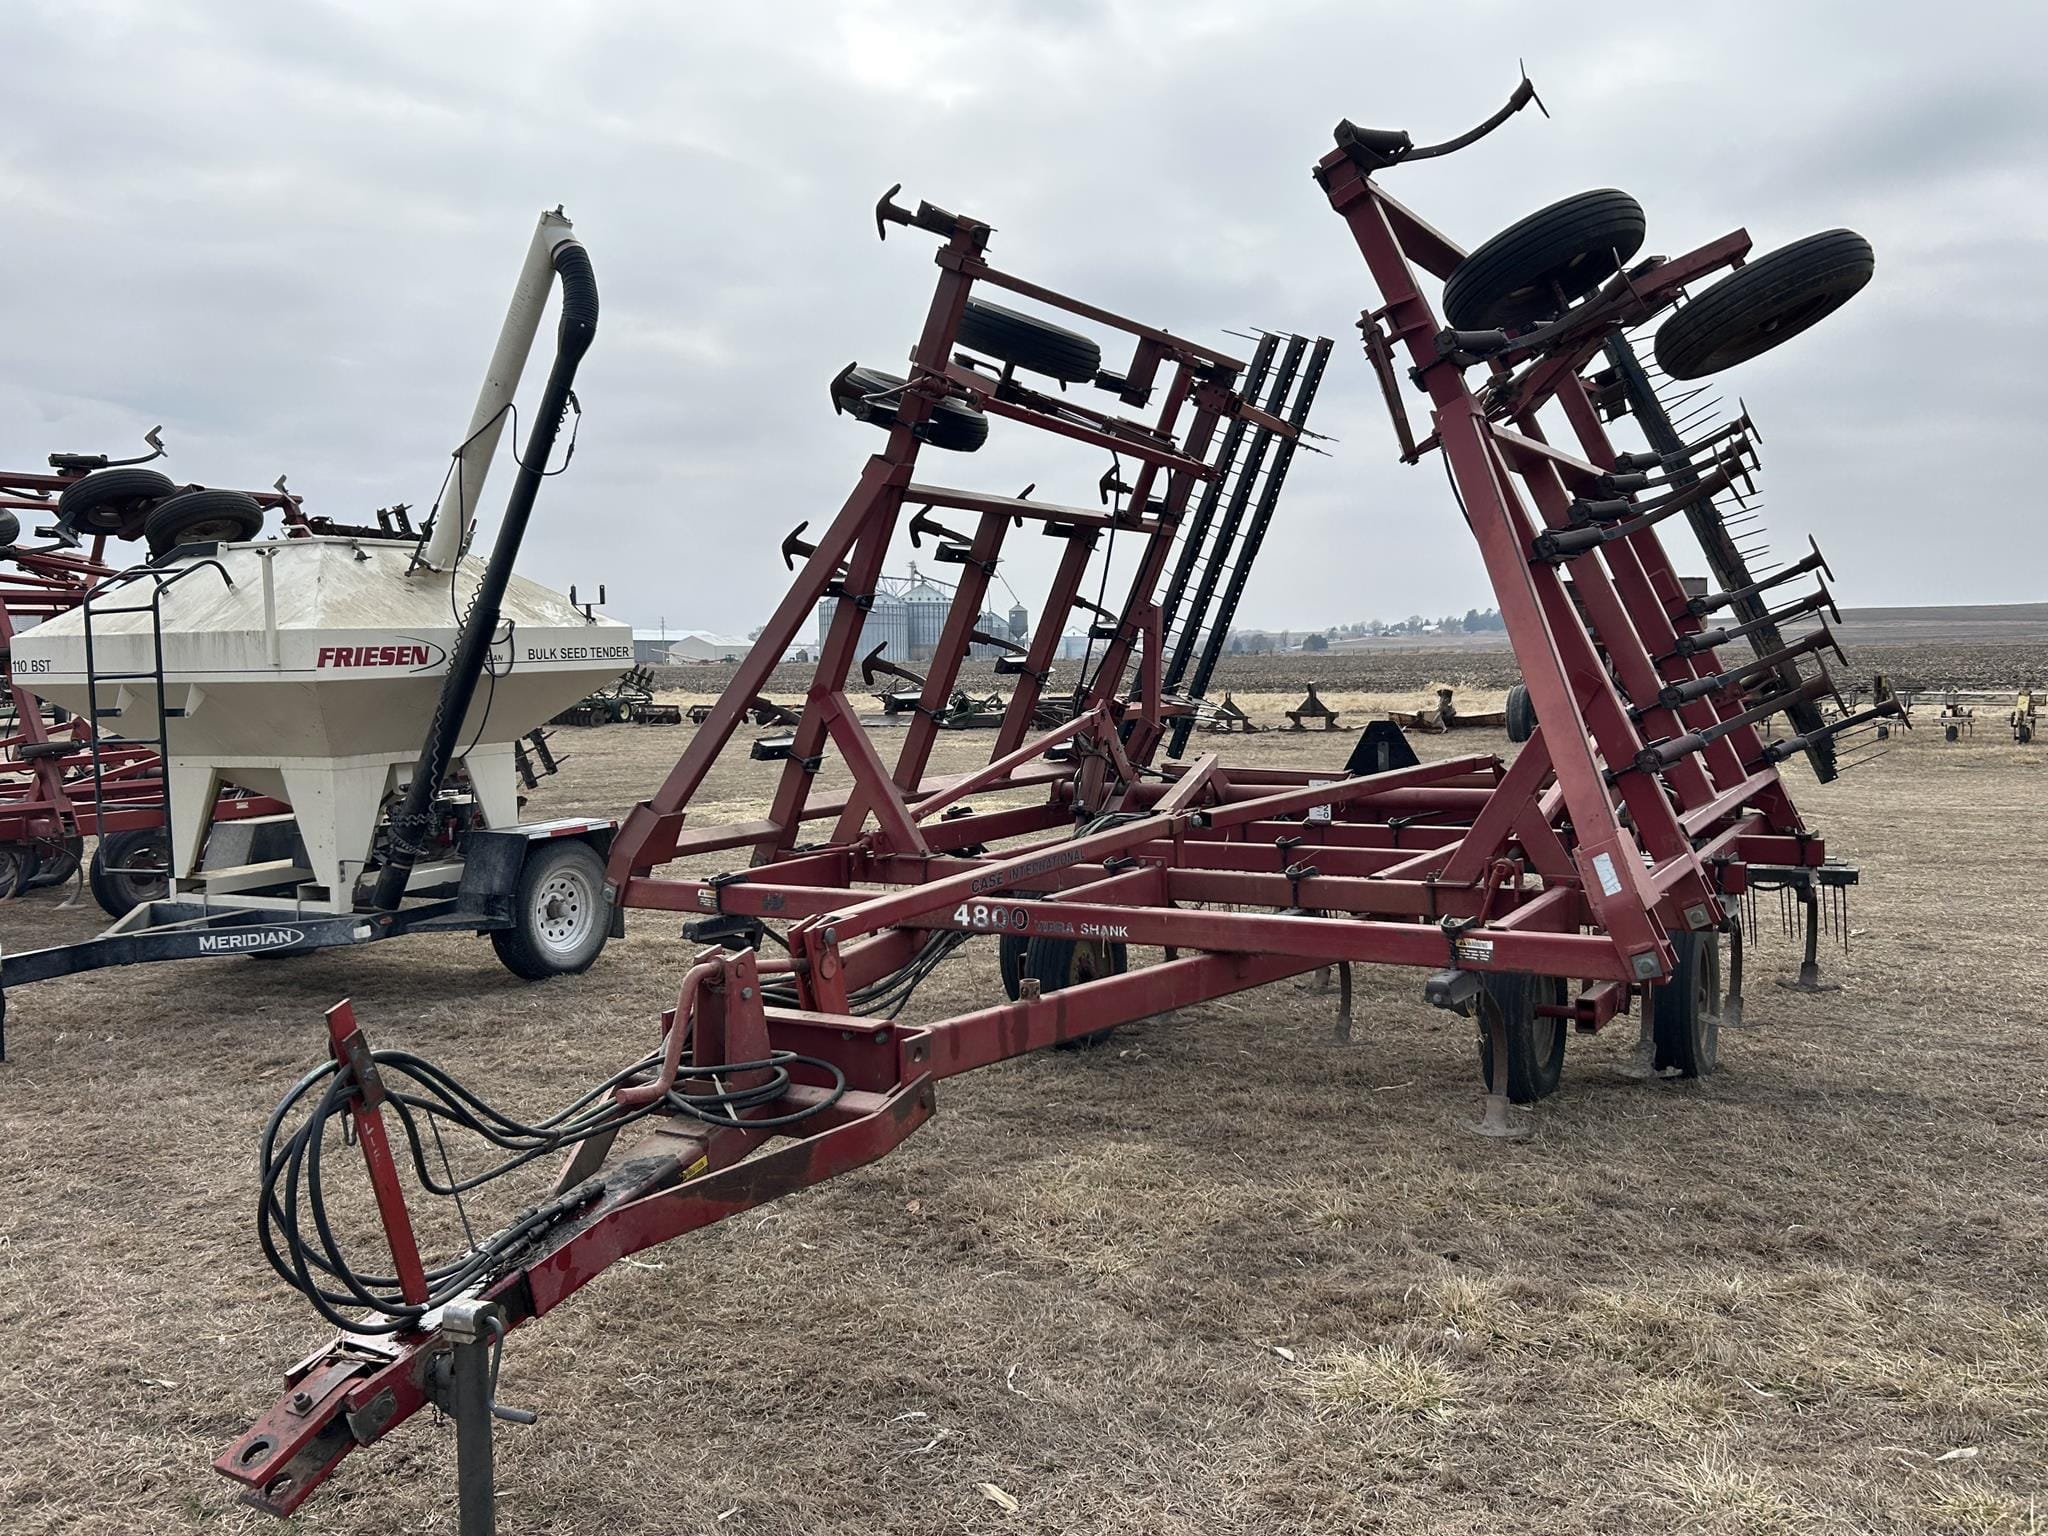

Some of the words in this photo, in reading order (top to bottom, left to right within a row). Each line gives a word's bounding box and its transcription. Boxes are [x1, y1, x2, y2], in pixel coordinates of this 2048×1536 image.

[317, 646, 430, 668] FRIESEN
[527, 648, 558, 660] BULK
[560, 647, 588, 659] SEED
[590, 646, 629, 658] TENDER
[12, 660, 28, 673] 110
[31, 659, 52, 673] BST
[971, 872, 1003, 892] CASE
[953, 903, 1030, 931] 4800
[1080, 923, 1129, 938] SHANK
[198, 930, 292, 951] MERIDIAN
